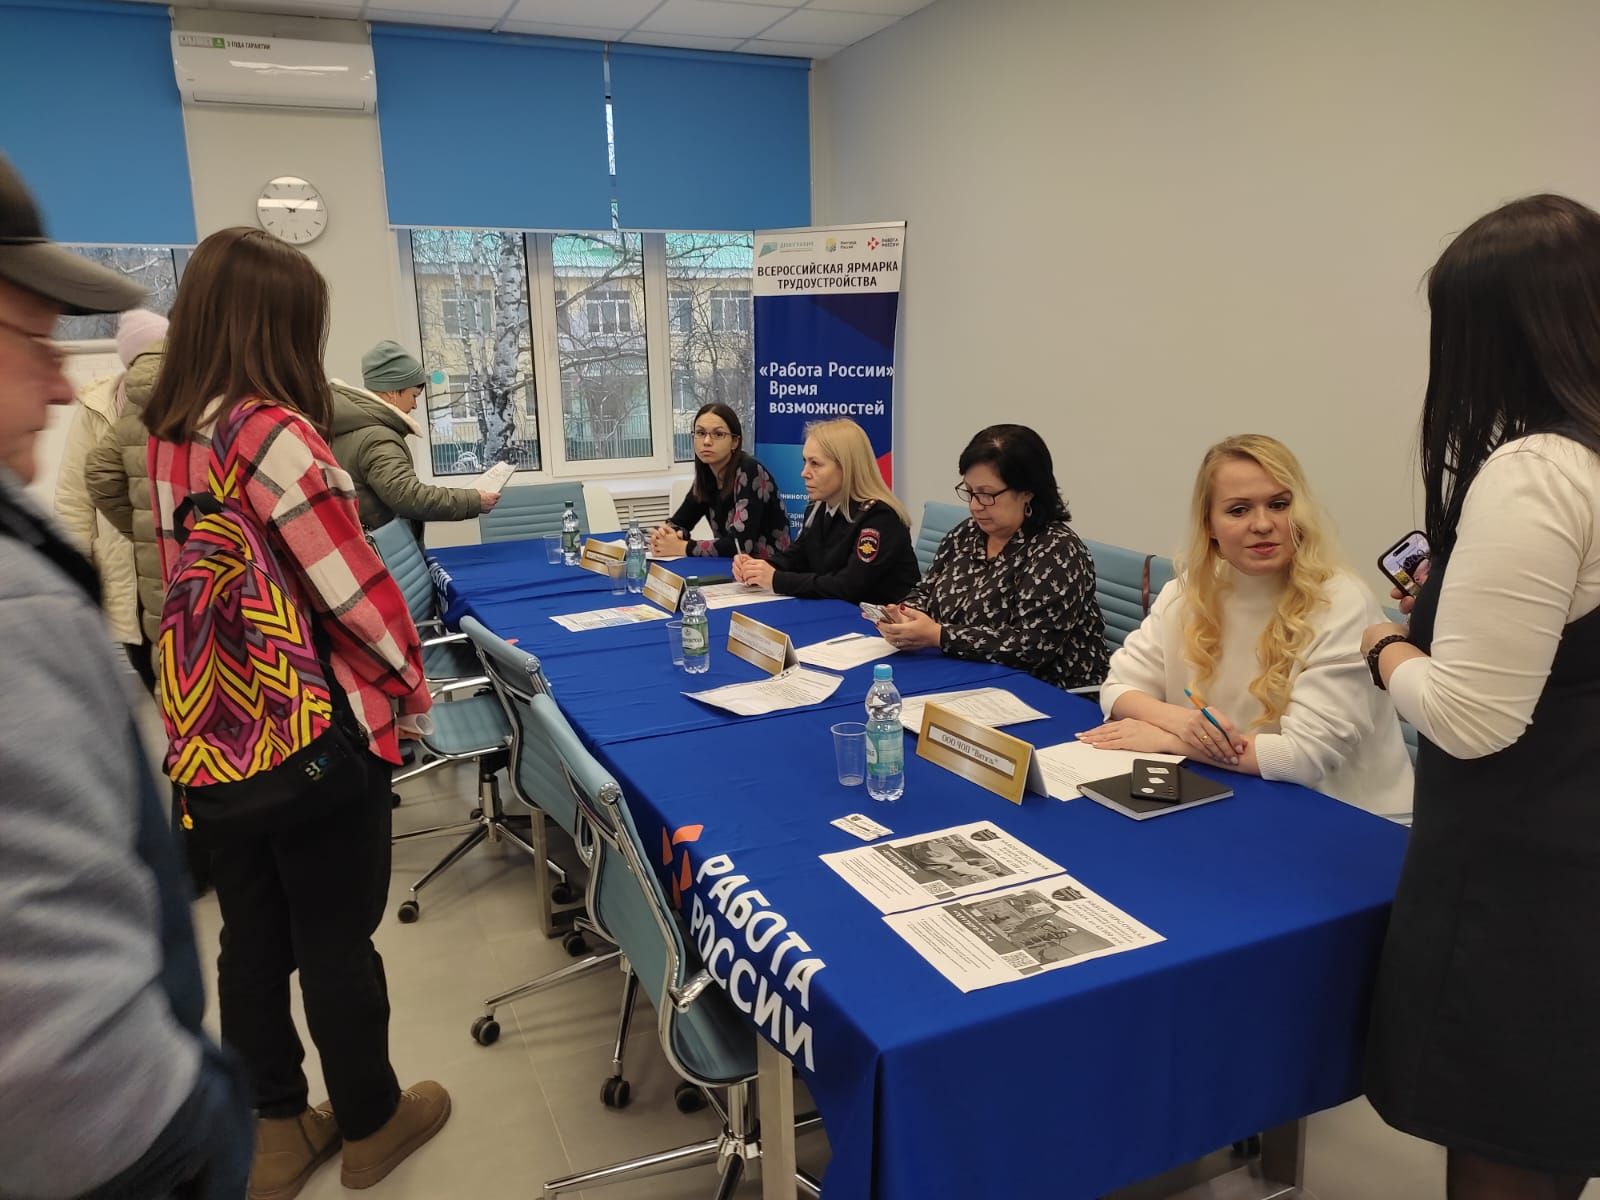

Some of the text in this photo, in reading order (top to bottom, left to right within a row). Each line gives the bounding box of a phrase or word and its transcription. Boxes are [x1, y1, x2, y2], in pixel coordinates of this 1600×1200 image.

[232, 41, 244, 49] ГОДА
[757, 260, 899, 277] ВСЕРОССИЙСКАЯ ЯРМАРКА
[777, 275, 877, 291] ТРУДОУСТРОЙСТВА
[759, 361, 895, 378] «Работа России»
[769, 380, 818, 399] Время
[769, 400, 885, 416] возможностей
[941, 733, 956, 747] ООО
[956, 738, 971, 754] ЧОП
[696, 854, 826, 1011] РАБОТА
[690, 893, 815, 1072] РОССИИ
